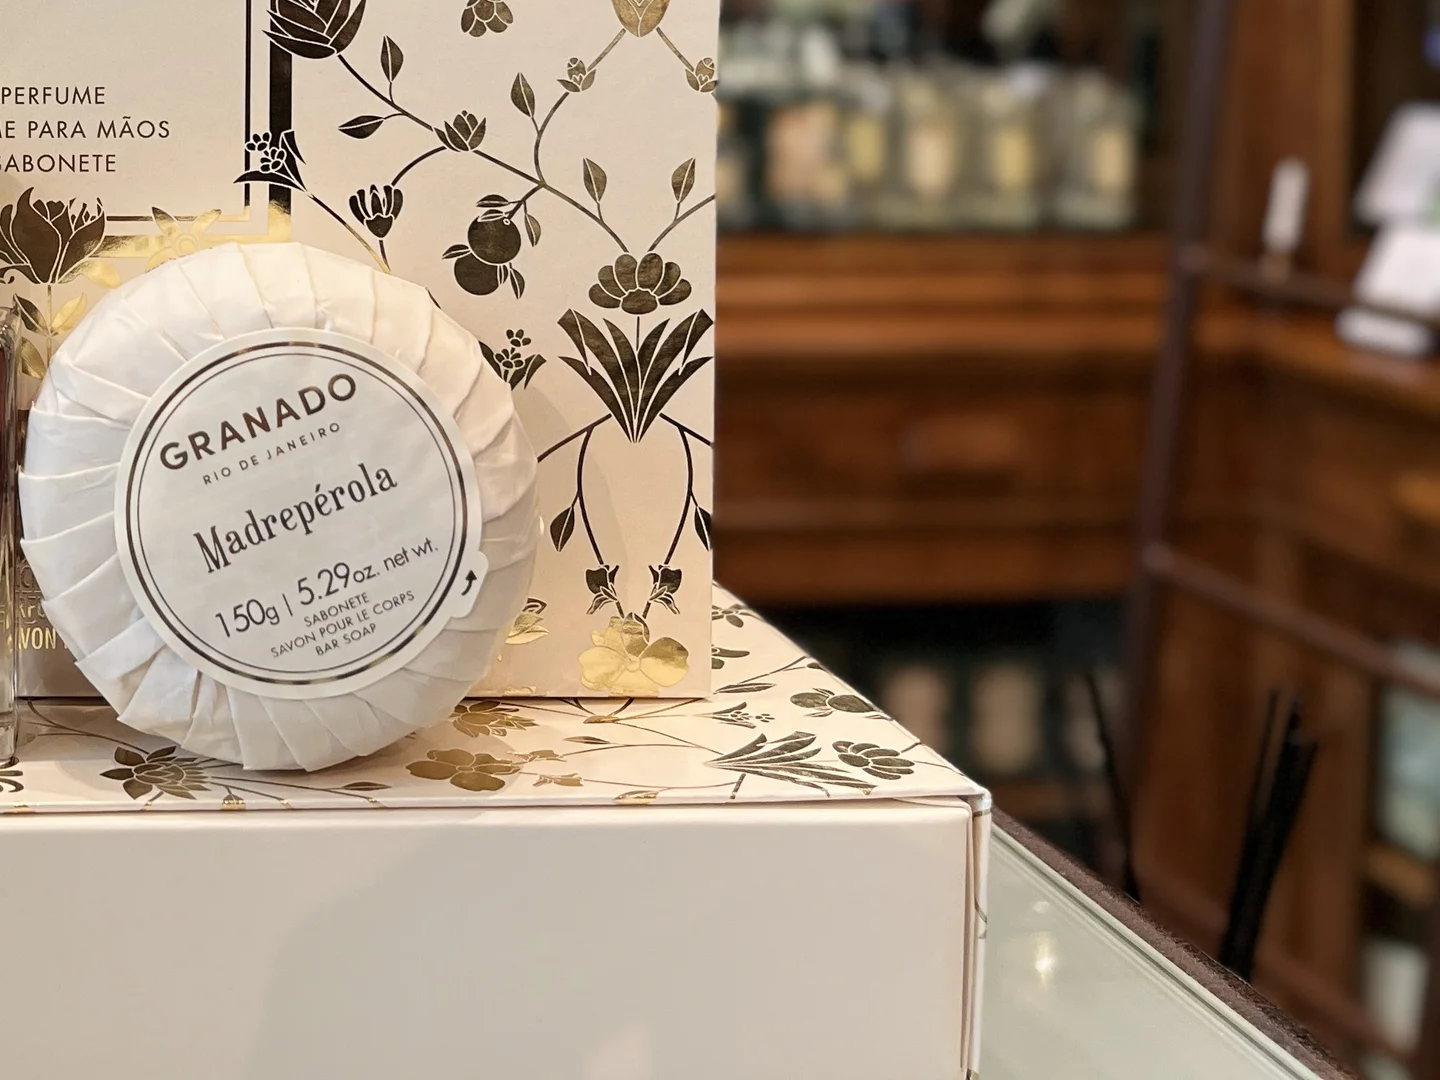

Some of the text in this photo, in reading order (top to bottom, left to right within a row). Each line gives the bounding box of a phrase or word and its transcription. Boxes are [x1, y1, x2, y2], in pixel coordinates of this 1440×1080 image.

[1, 86, 105, 105] PERFUME
[27, 120, 87, 139] PARA
[96, 116, 170, 139] MÃOS
[159, 373, 357, 471] GRANADO
[202, 422, 341, 486] RIO DE JANEIRO
[193, 462, 398, 574] Madrepérola
[215, 598, 281, 638] 150g
[383, 547, 410, 571] net
[412, 537, 439, 558] wt.
[304, 592, 370, 628] SABONETE
[270, 590, 415, 658] SAVON POUR LE CORPS
[315, 623, 377, 656] BAR SOAP
